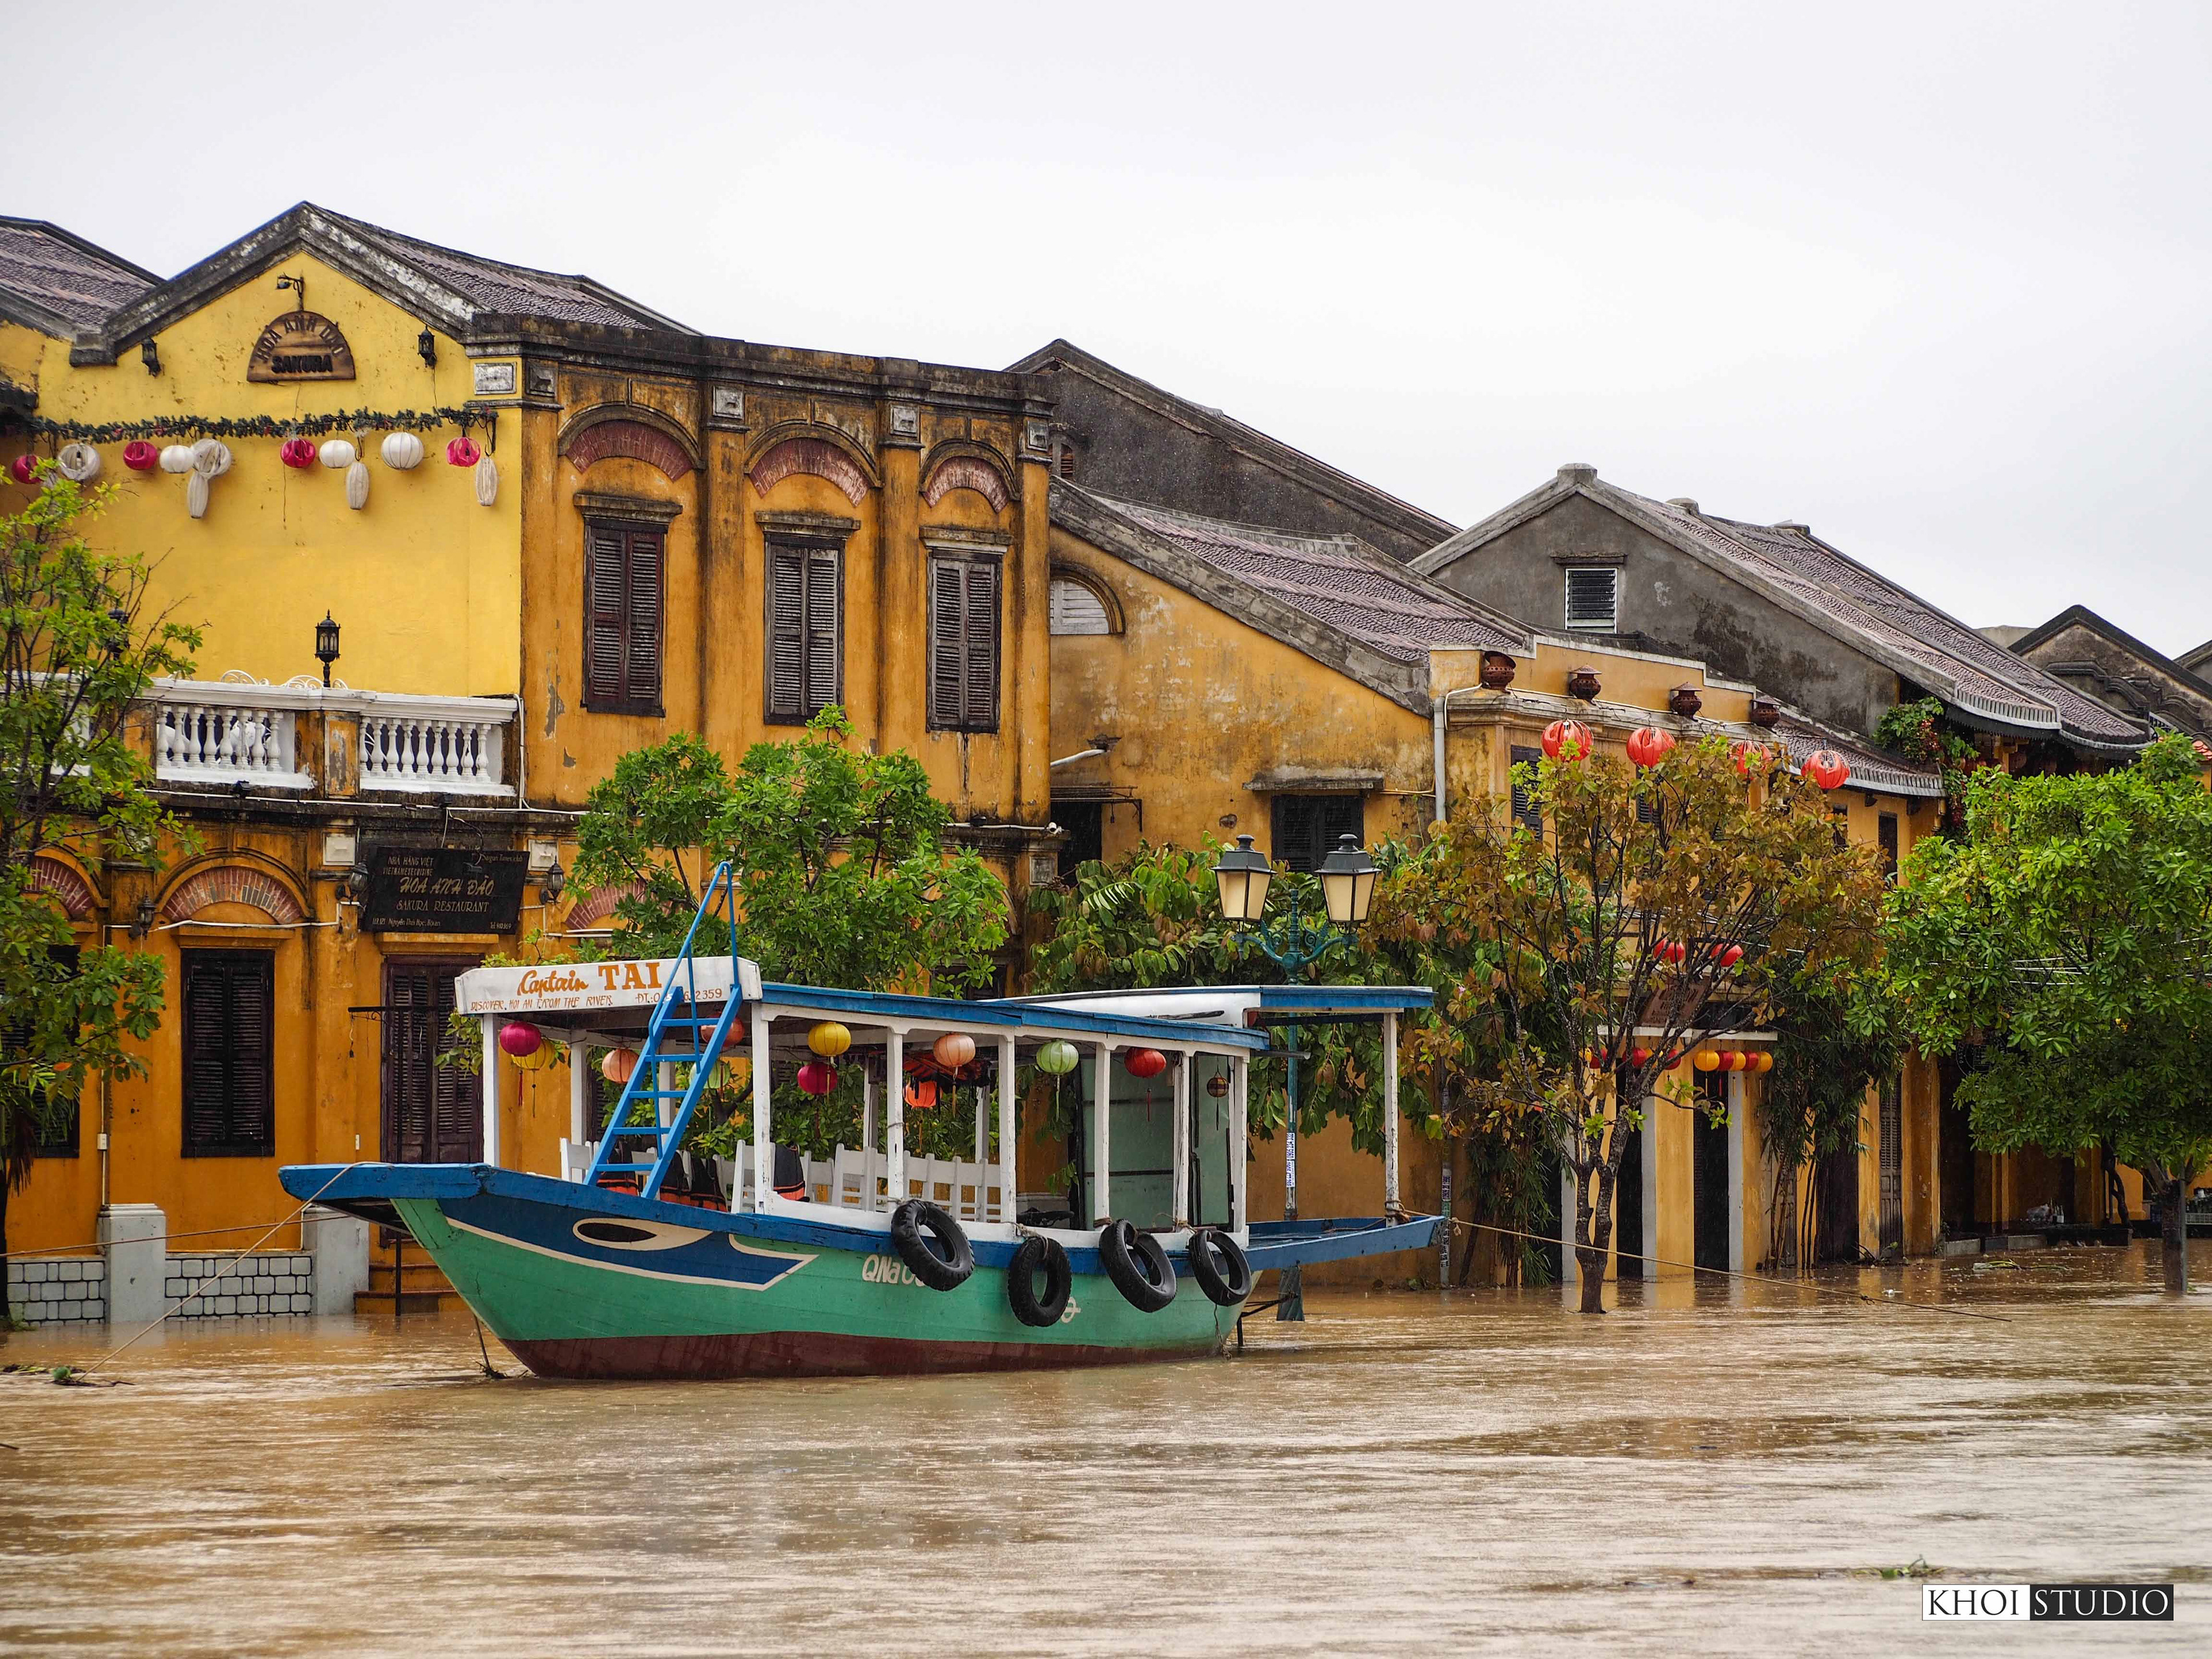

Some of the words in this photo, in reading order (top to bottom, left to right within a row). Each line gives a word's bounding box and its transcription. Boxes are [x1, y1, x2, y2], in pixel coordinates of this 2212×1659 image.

[255, 329, 282, 363] HOA
[283, 315, 317, 334] ANH
[271, 355, 333, 373] SAKURA
[400, 877, 429, 893] HOA
[430, 877, 464, 895] ANH
[396, 899, 429, 911] SAKURA
[433, 900, 490, 912] RESTAURANT
[517, 969, 589, 998] Captain
[598, 962, 662, 991] TAI
[522, 999, 533, 1008] AN
[537, 997, 561, 1008] FROM
[564, 997, 580, 1007] THE
[586, 995, 613, 1006] RIVER
